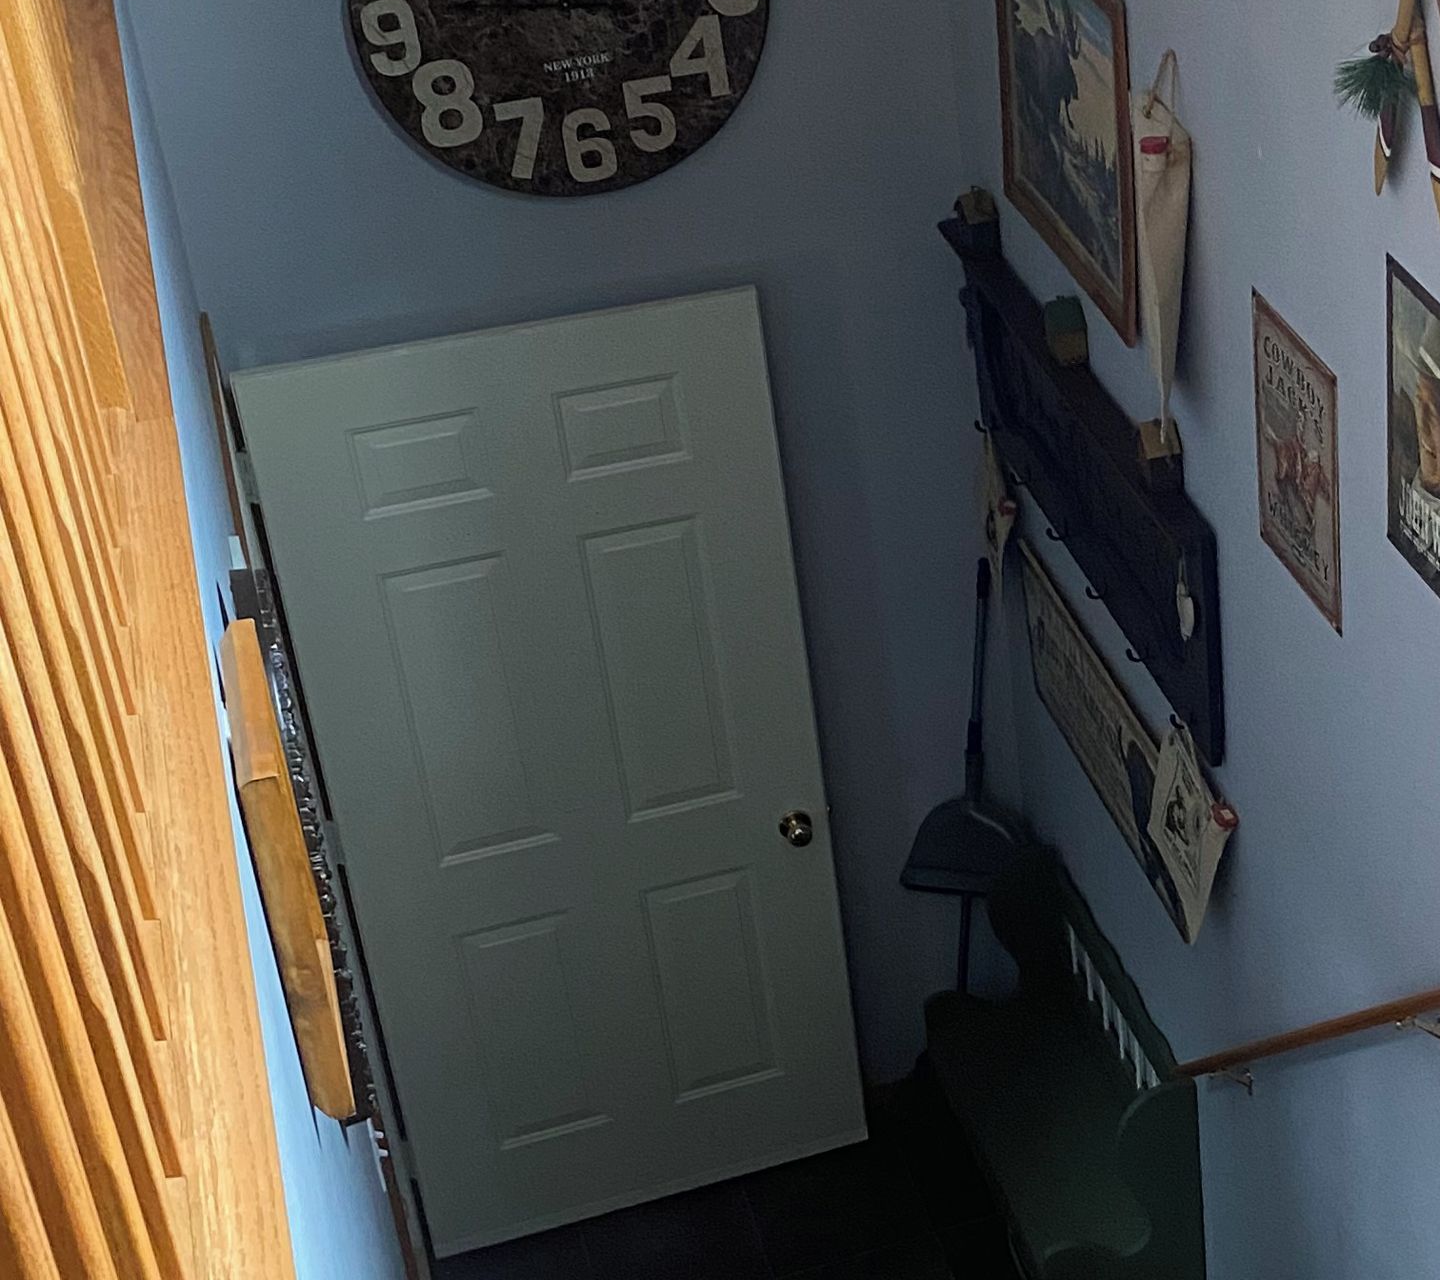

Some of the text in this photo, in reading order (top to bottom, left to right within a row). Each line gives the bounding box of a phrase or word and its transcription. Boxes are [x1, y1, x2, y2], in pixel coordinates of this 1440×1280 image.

[543, 52, 611, 73] NEW YORK
[669, 14, 731, 98] 4
[412, 59, 484, 148] 8
[493, 97, 545, 179] 7
[622, 75, 678, 153] 5
[561, 108, 618, 183] 6
